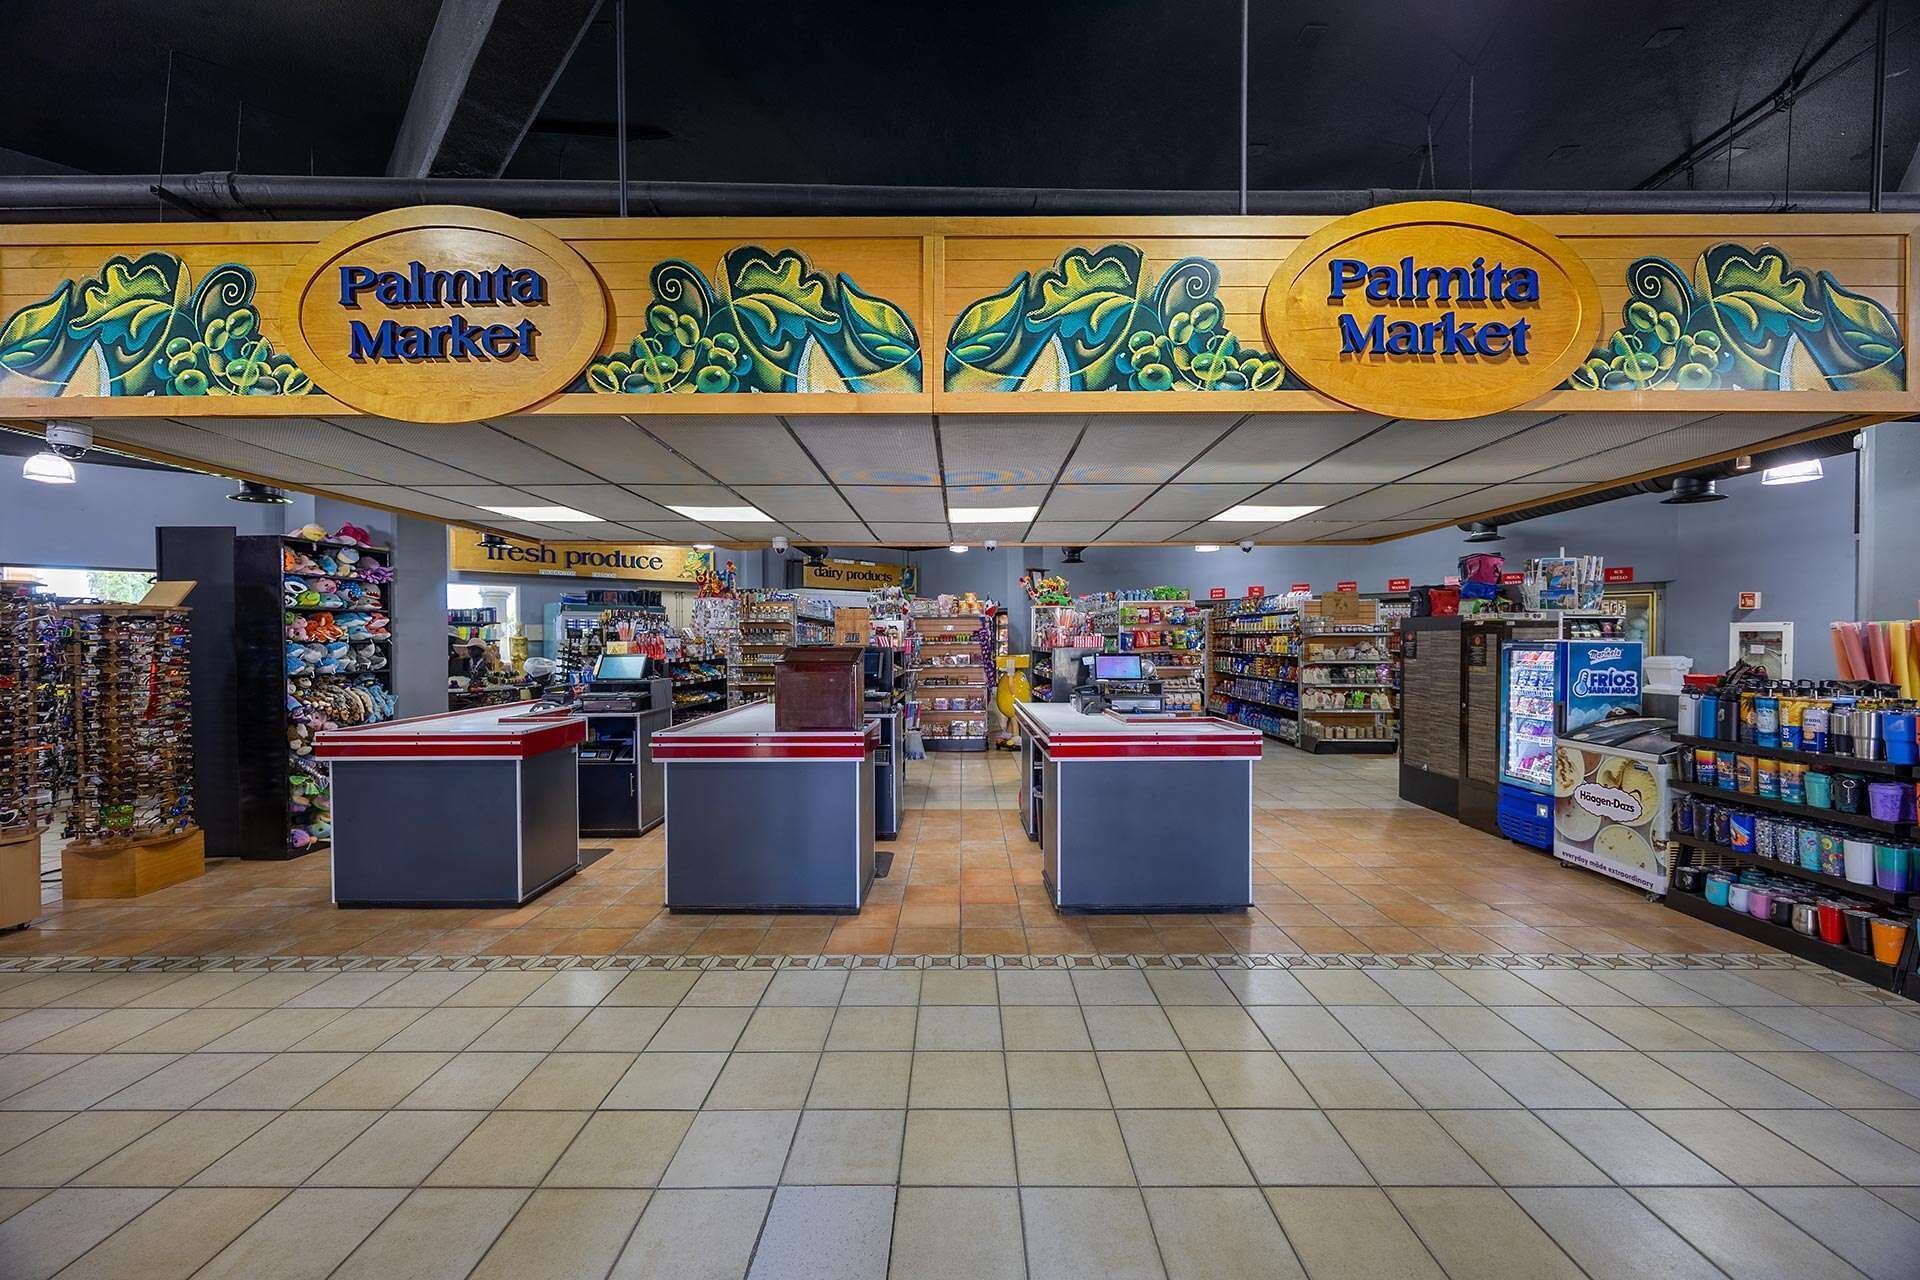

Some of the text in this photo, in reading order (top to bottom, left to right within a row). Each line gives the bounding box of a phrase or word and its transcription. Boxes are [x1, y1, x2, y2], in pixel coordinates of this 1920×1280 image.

[338, 261, 546, 307] Palmita
[1328, 256, 1540, 302] Palmita
[348, 314, 539, 361] Market
[1338, 311, 1532, 357] Market
[487, 541, 663, 571] fresh produce
[814, 566, 893, 582] dairy products
[1590, 669, 1635, 687] FRÍOS
[1611, 687, 1636, 695] MEJOR
[1580, 790, 1635, 813] Häagen-Dazs
[1562, 850, 1589, 865] everyday
[1608, 866, 1654, 889] extraordinary
